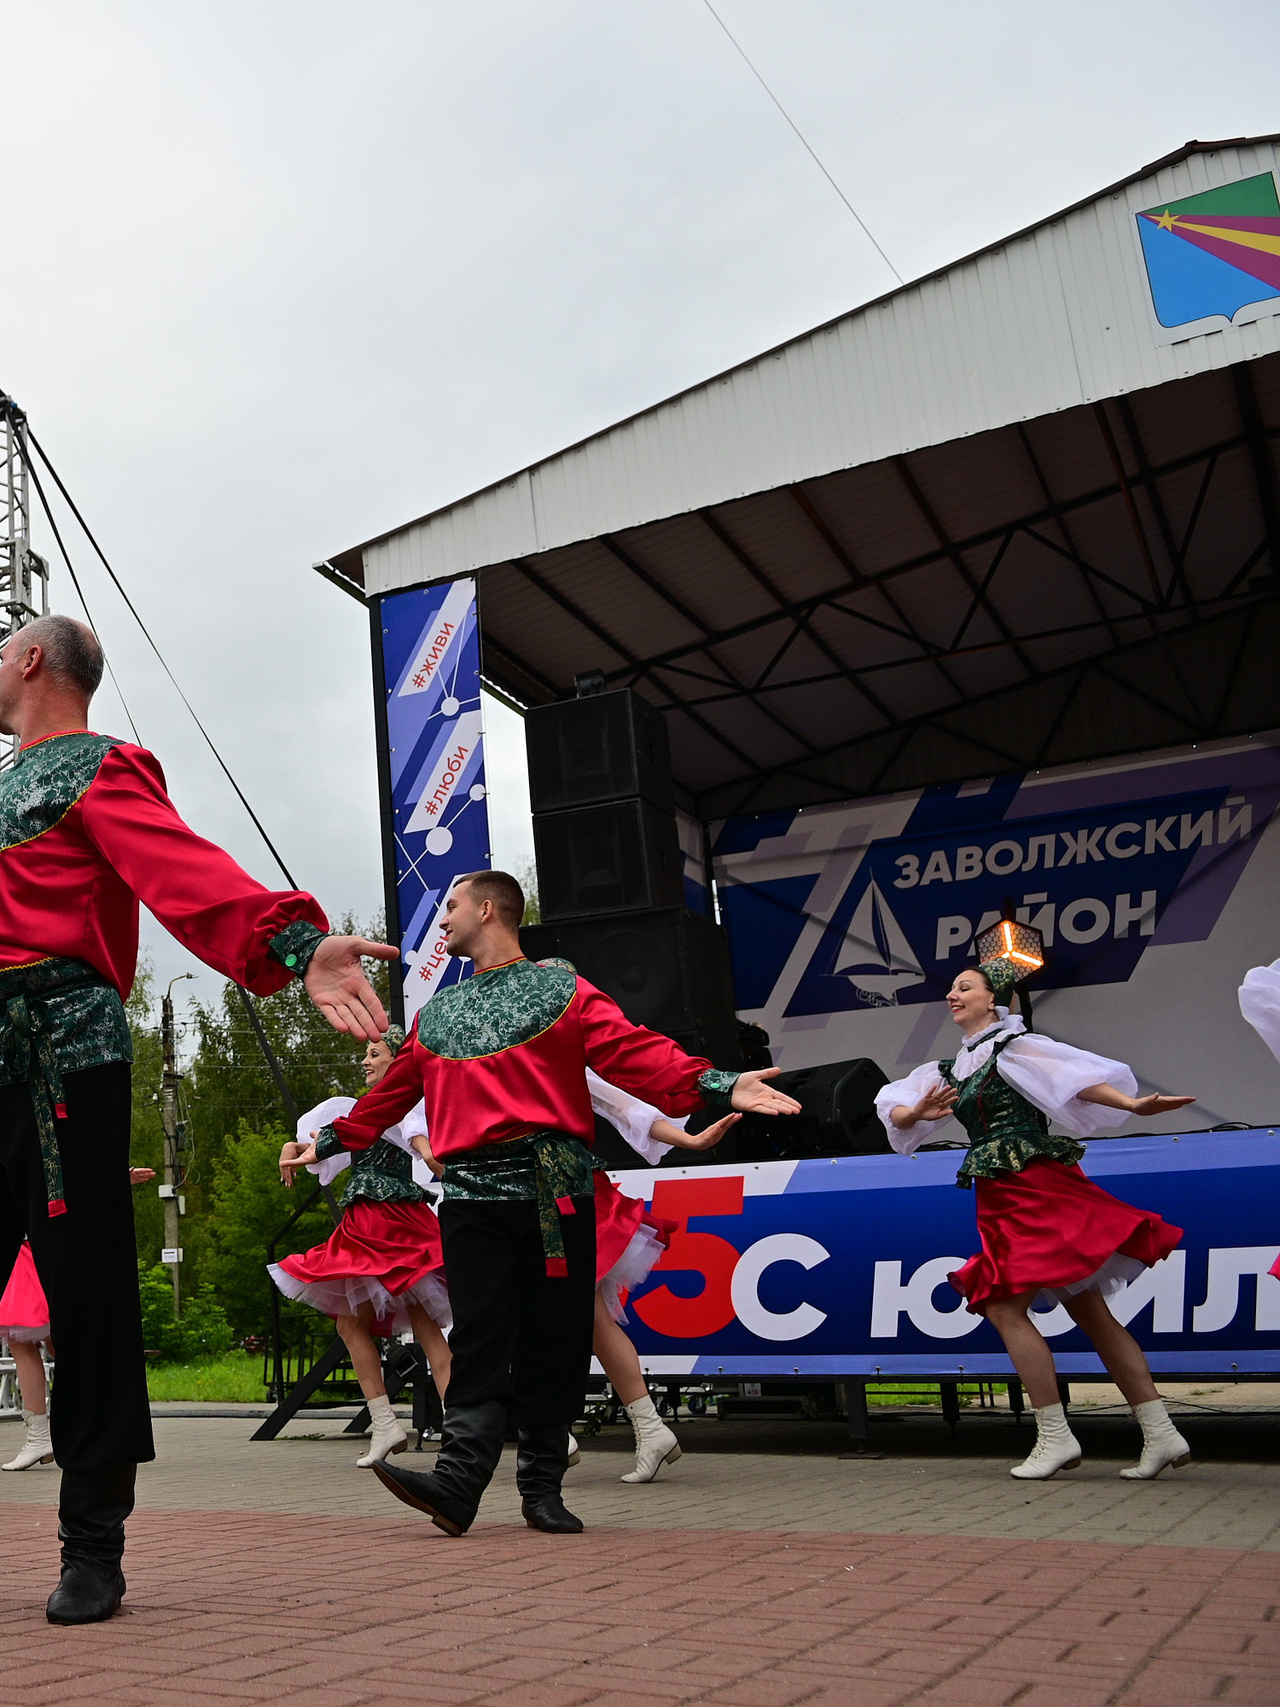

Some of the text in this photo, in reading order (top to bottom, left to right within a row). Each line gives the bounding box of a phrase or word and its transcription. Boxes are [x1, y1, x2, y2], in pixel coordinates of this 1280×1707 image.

[412, 621, 455, 689] #живи
[424, 745, 469, 817] #люби
[892, 796, 1253, 889] ЗАВОЛЖСКИЙ
